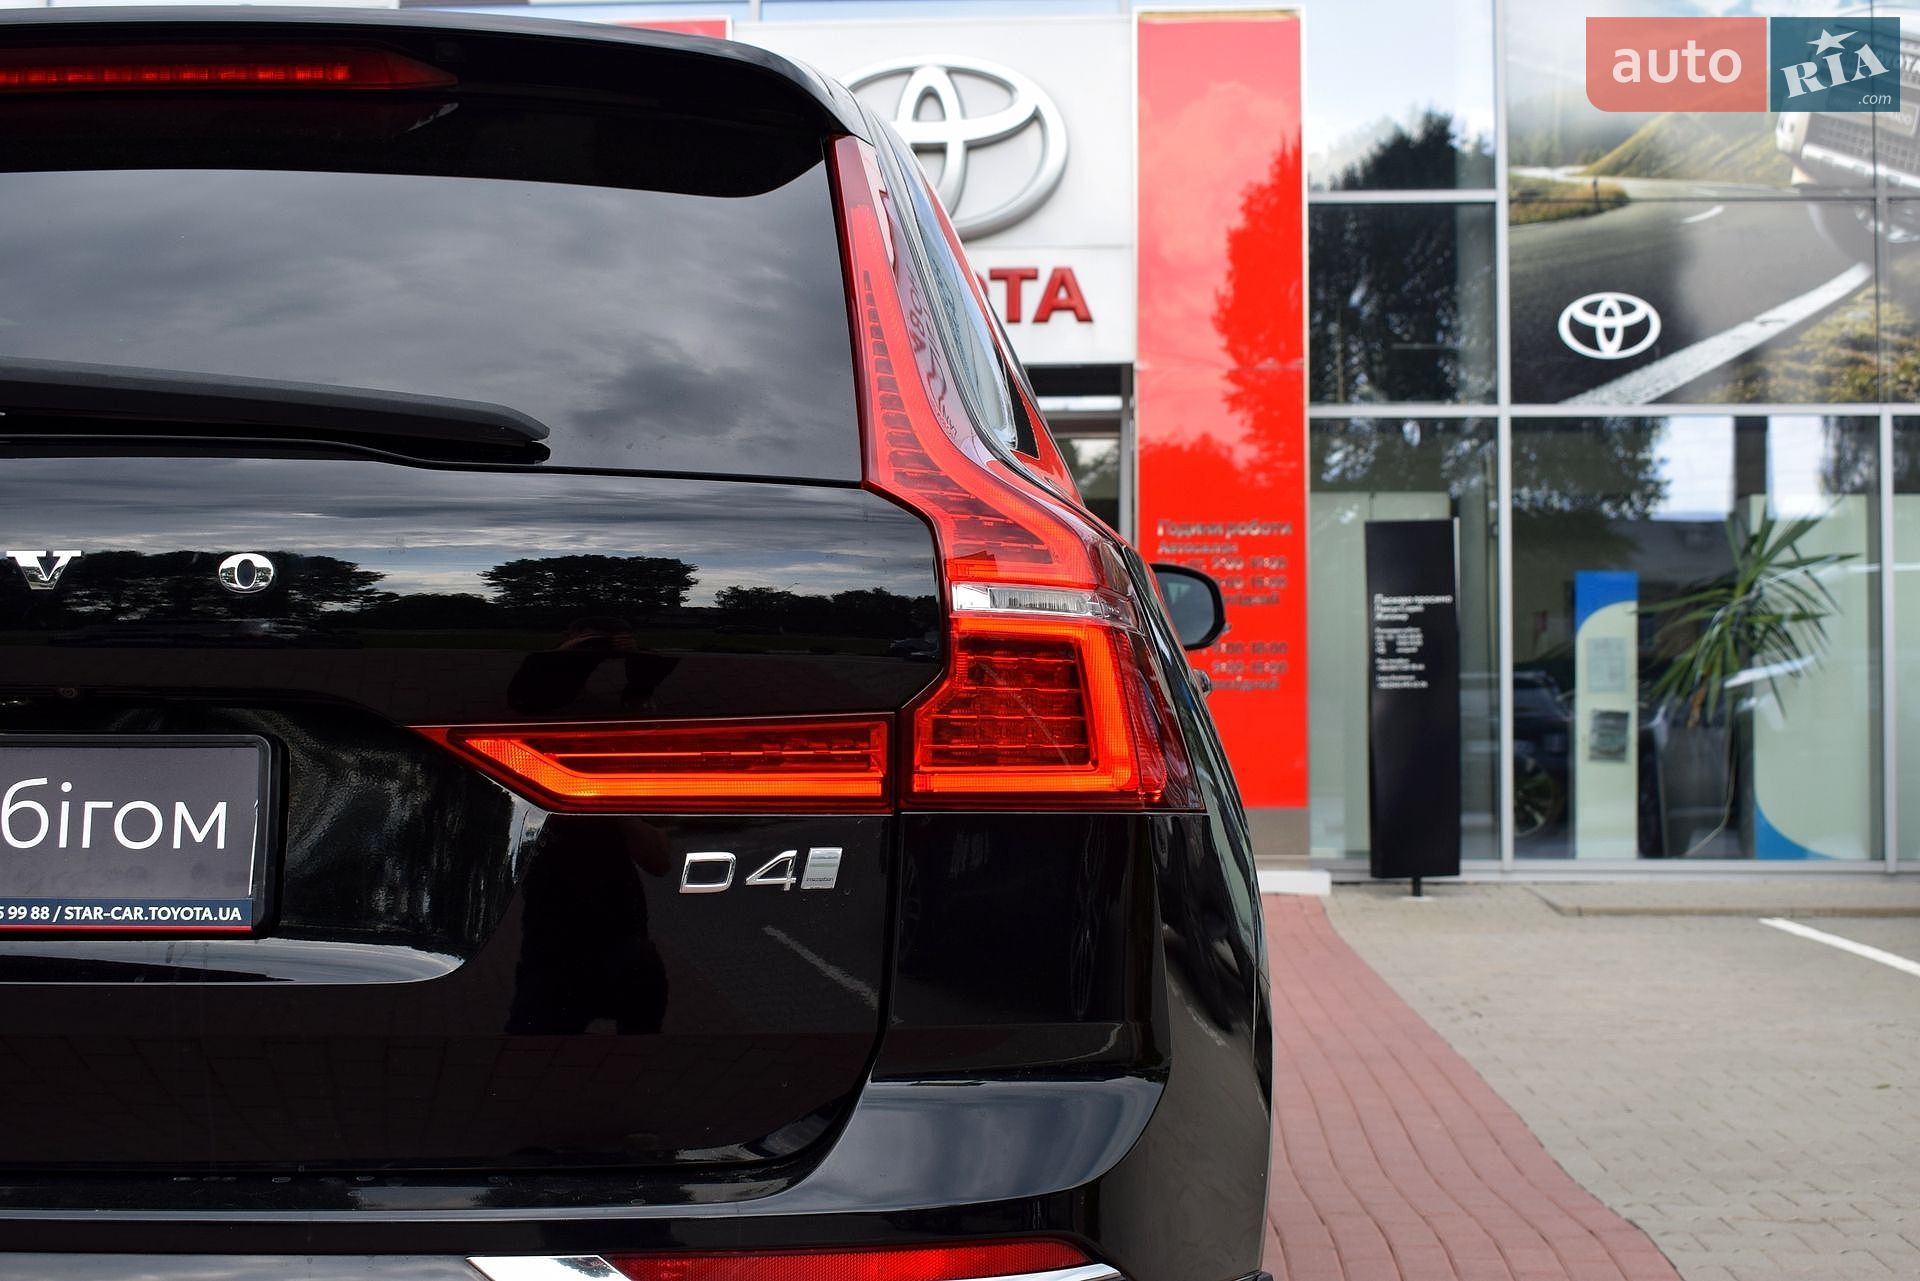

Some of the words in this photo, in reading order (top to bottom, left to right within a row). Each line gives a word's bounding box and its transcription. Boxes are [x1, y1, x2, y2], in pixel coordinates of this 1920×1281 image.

[974, 267, 1093, 323] TA
[1, 777, 227, 849] бігом
[8, 906, 28, 920] 99
[30, 906, 50, 920] 88
[64, 906, 242, 921] STAR-CAR.TOYOTA.UA
